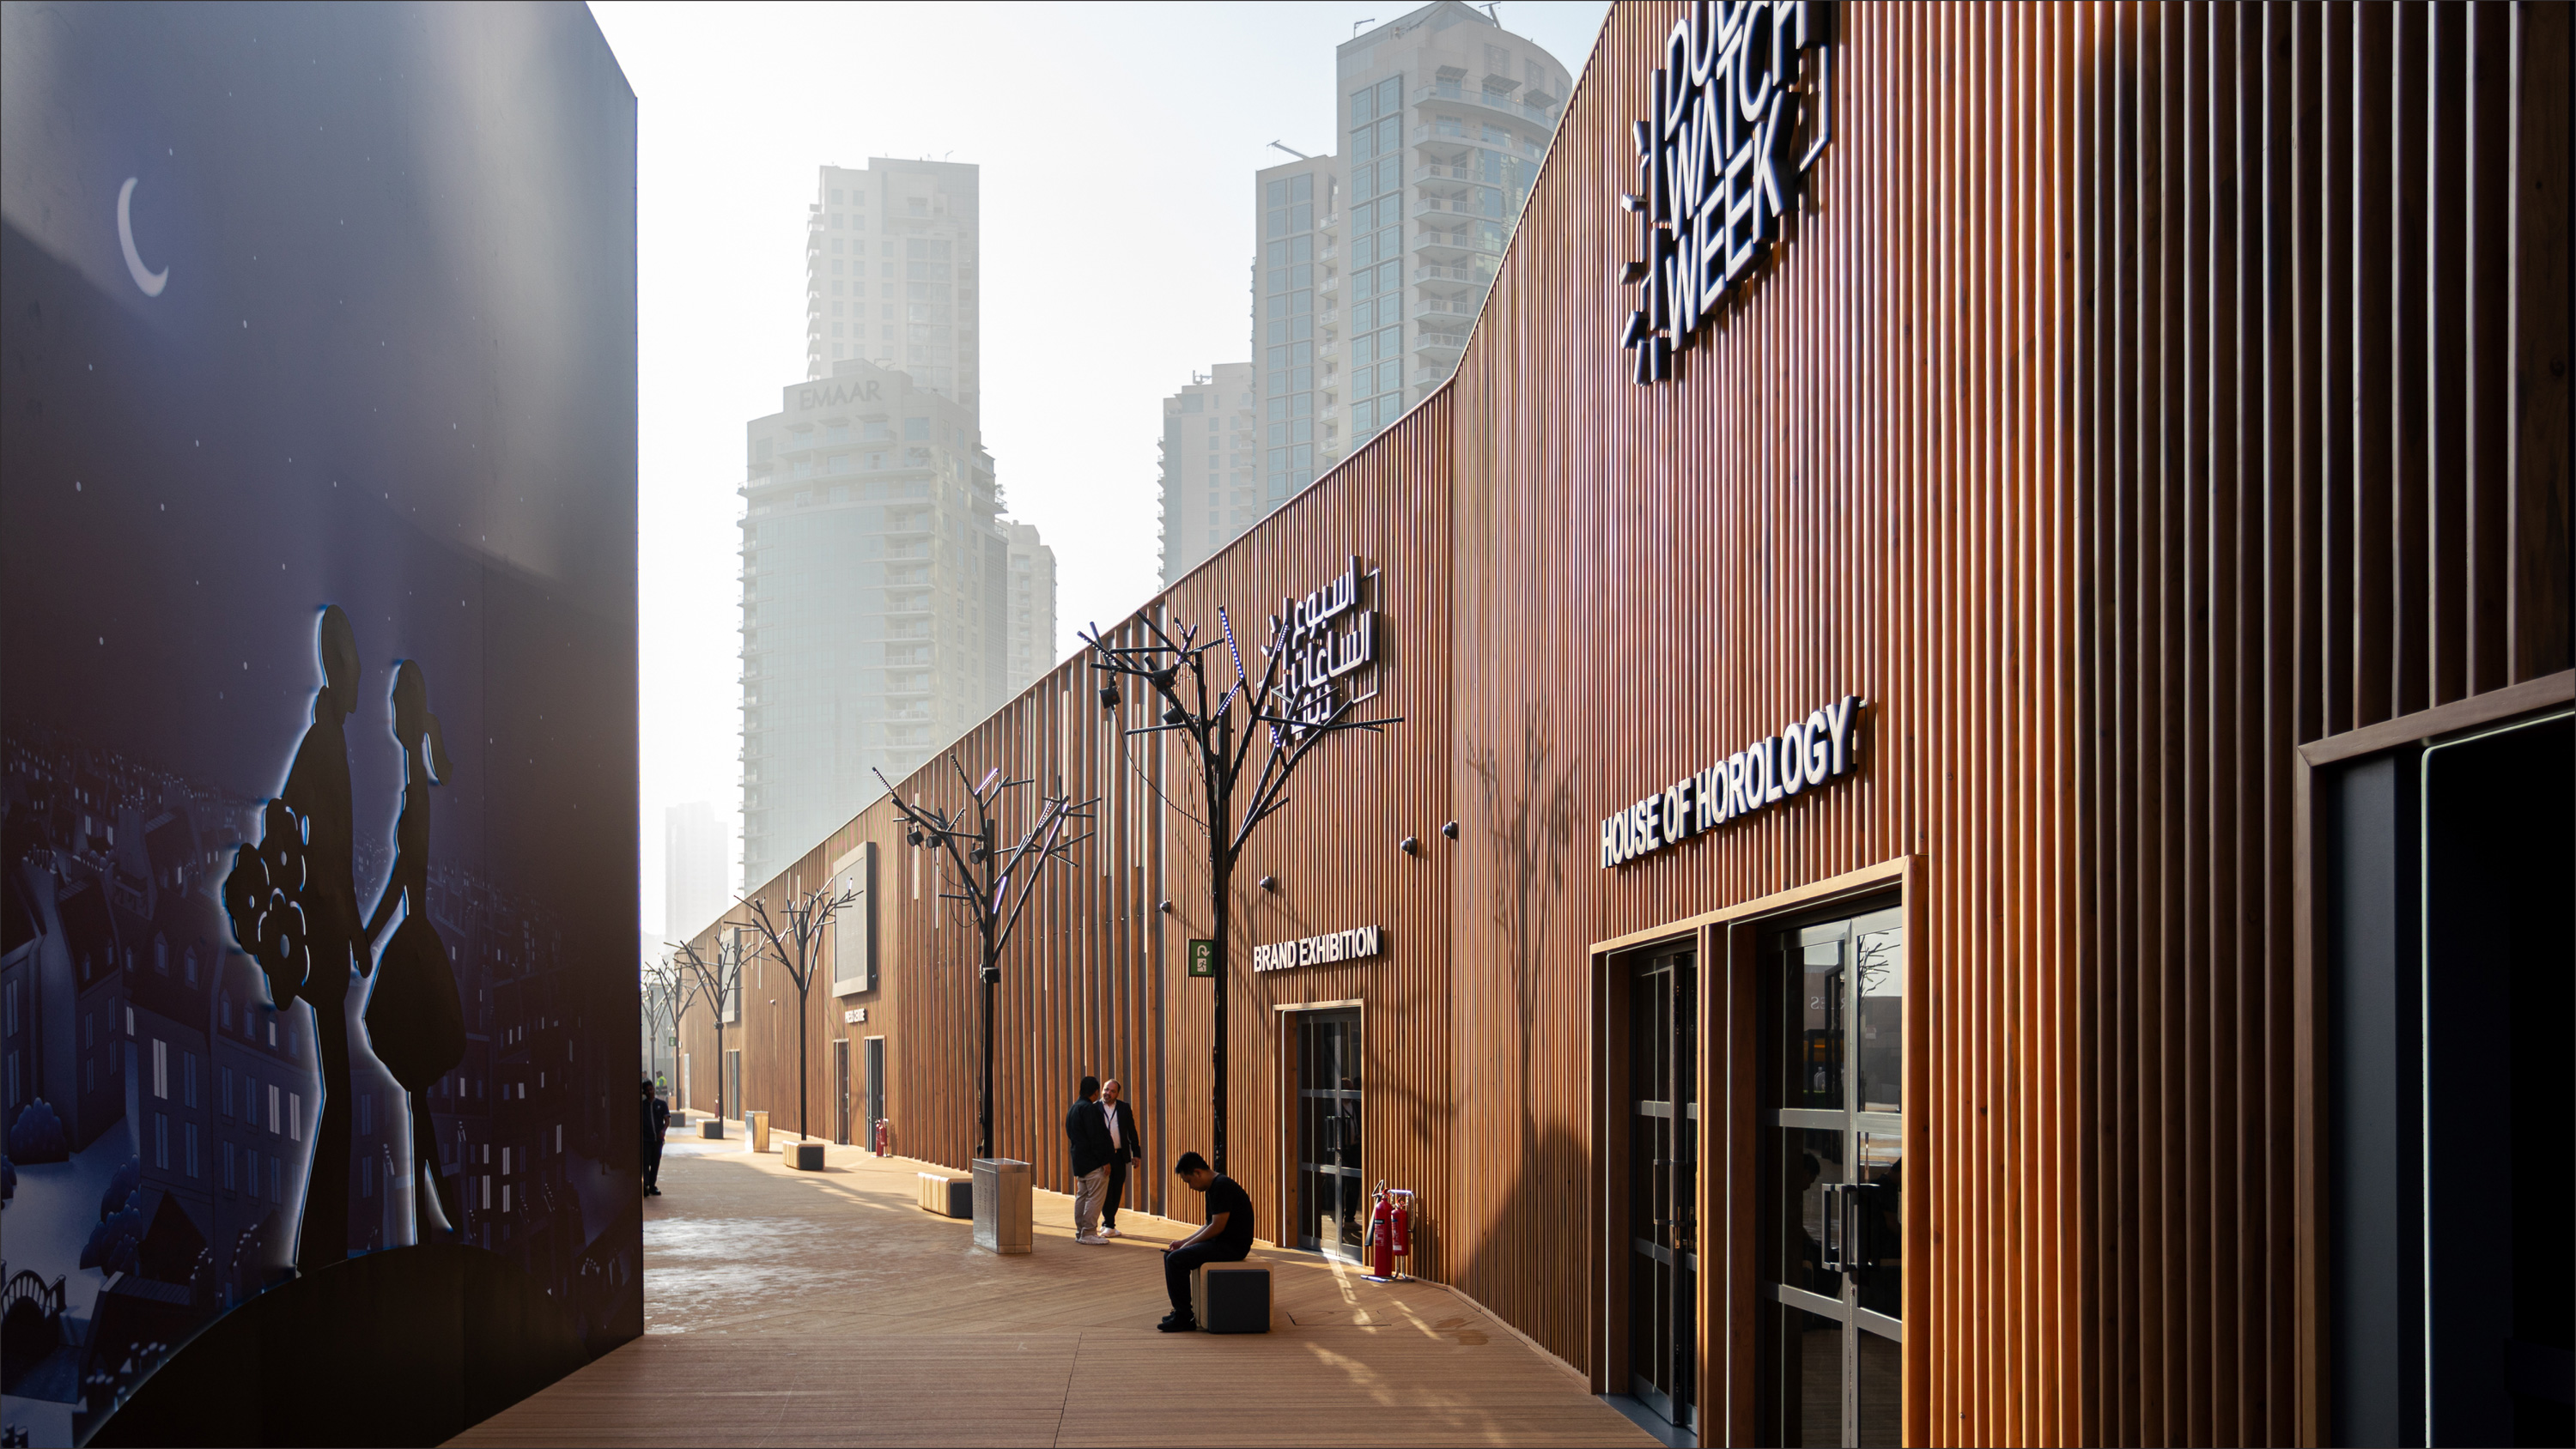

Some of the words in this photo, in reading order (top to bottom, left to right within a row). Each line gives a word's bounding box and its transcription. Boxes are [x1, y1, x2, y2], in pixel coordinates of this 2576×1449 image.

[1666, 90, 1783, 351] WEEK
[799, 380, 882, 410] EMAAR
[1602, 793, 1661, 869] HOUSE
[1663, 778, 1694, 844] OF
[1696, 695, 1860, 834] HOROLOGY
[1254, 941, 1297, 973] BRAND
[1299, 925, 1377, 967] EXHIBITION
